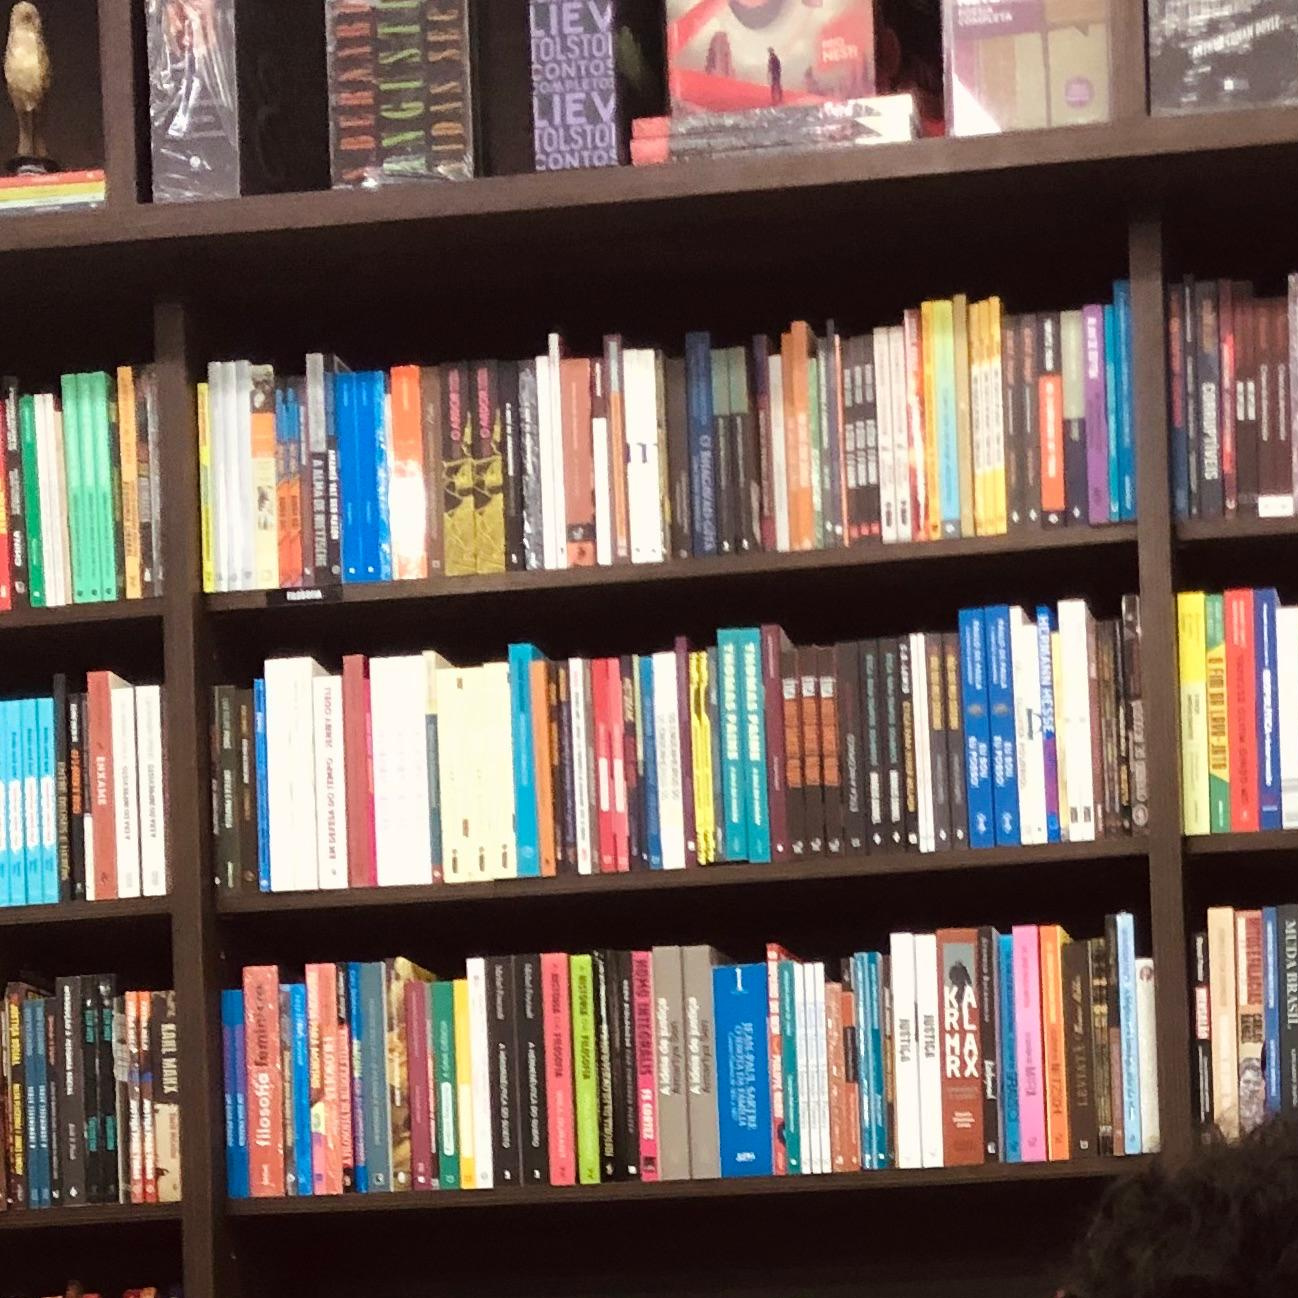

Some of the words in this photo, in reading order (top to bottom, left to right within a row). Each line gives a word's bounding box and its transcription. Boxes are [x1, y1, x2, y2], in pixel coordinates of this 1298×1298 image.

[533, 92, 616, 127] LIEV
[1038, 614, 1052, 685] HERMANN
[1041, 688, 1054, 733] HESSE
[1285, 920, 1298, 970] MUDA
[255, 1073, 272, 1146] filosofia
